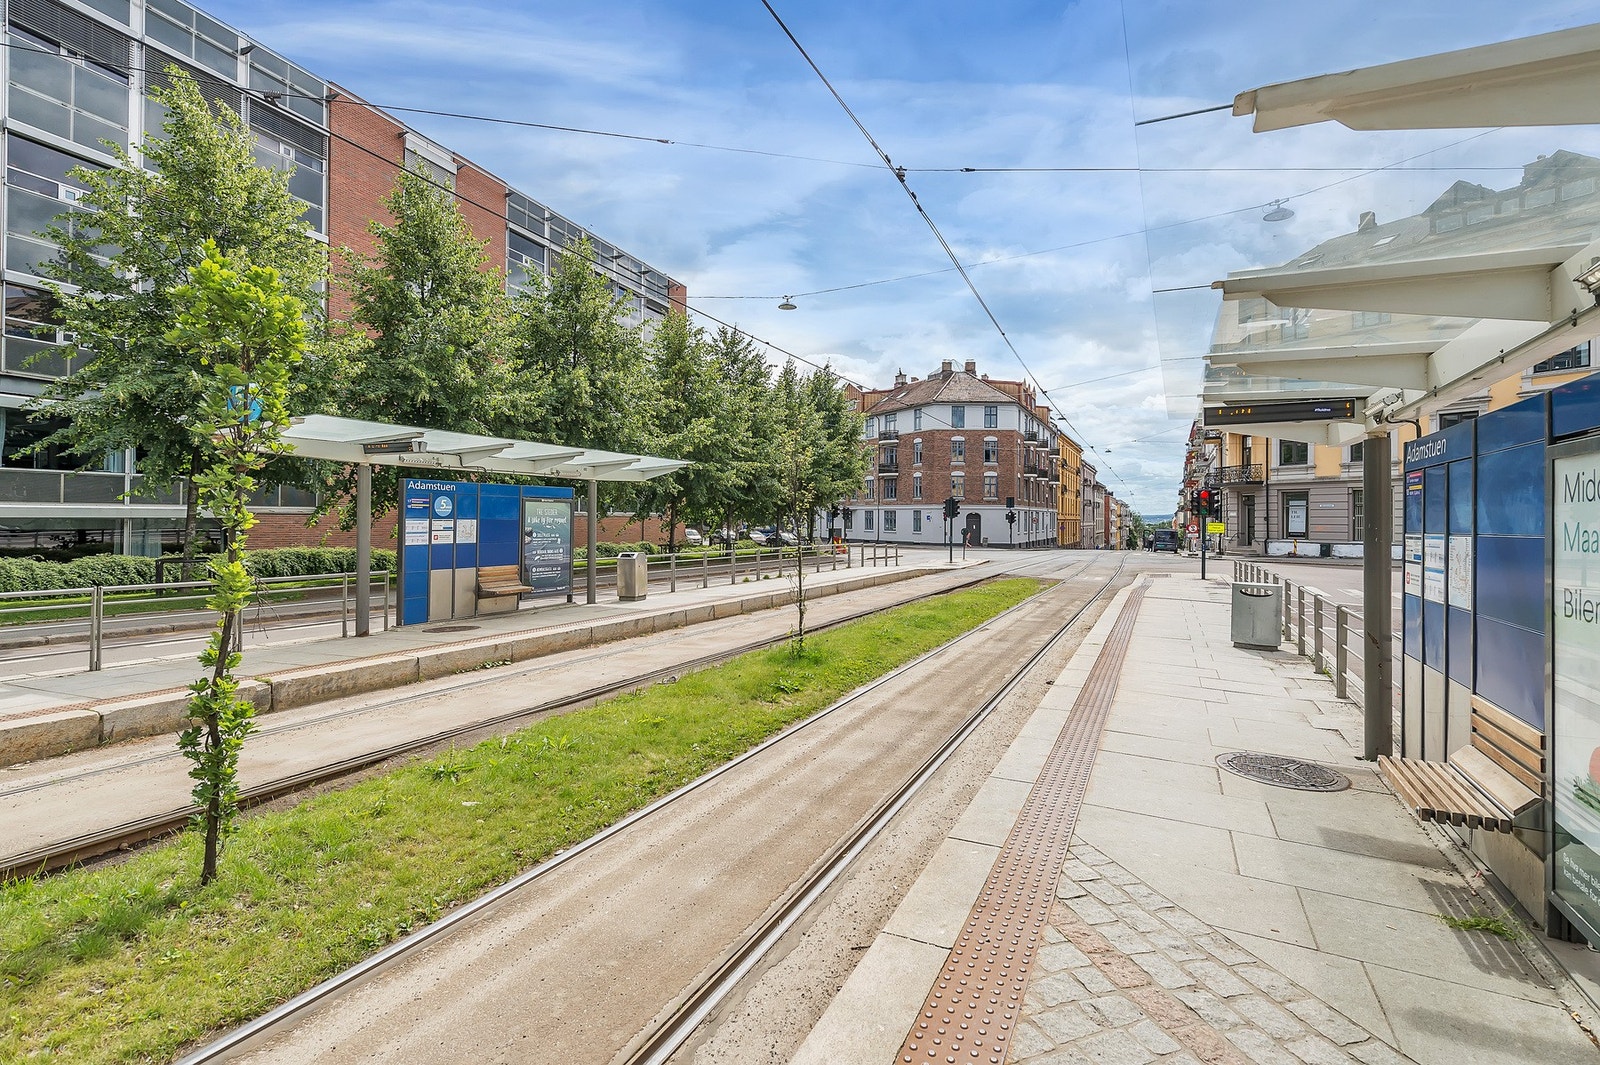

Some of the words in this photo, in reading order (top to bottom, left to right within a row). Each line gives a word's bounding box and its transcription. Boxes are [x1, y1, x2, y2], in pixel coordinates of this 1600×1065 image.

[1406, 438, 1447, 463] Adamstuen
[407, 480, 456, 492] Adamstuen
[1563, 468, 1600, 504] Mid
[440, 499, 447, 509] 5
[1563, 852, 1570, 865] Se
[1569, 857, 1579, 873] hva
[1579, 868, 1590, 882] mer
[1563, 865, 1572, 881] kan
[1572, 872, 1589, 896] betale
[1589, 888, 1598, 903] for
